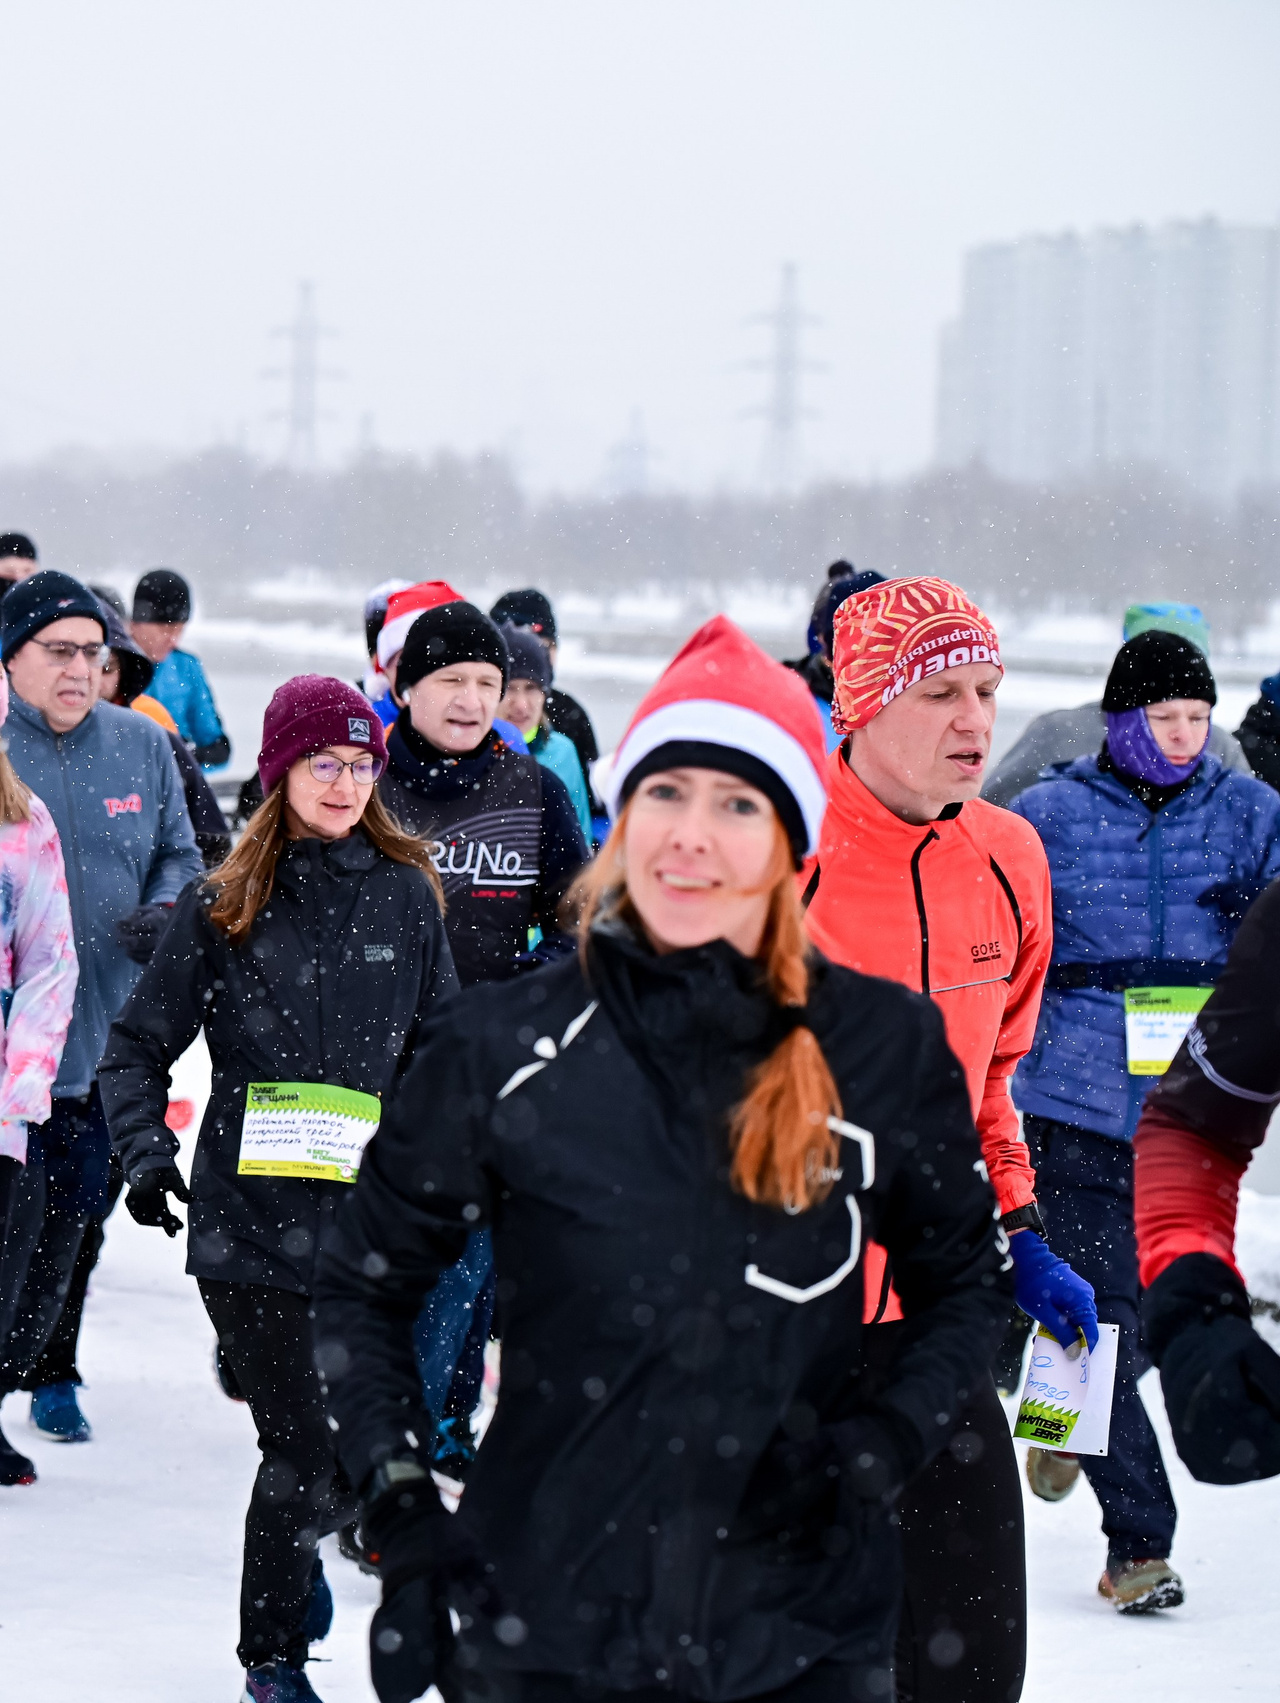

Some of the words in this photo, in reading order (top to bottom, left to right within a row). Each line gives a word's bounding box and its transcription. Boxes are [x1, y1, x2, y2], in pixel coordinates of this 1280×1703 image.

[888, 627, 983, 676] Царицыно
[970, 941, 1001, 957] GORE
[1030, 1427, 1065, 1443] ЗАБЕГ
